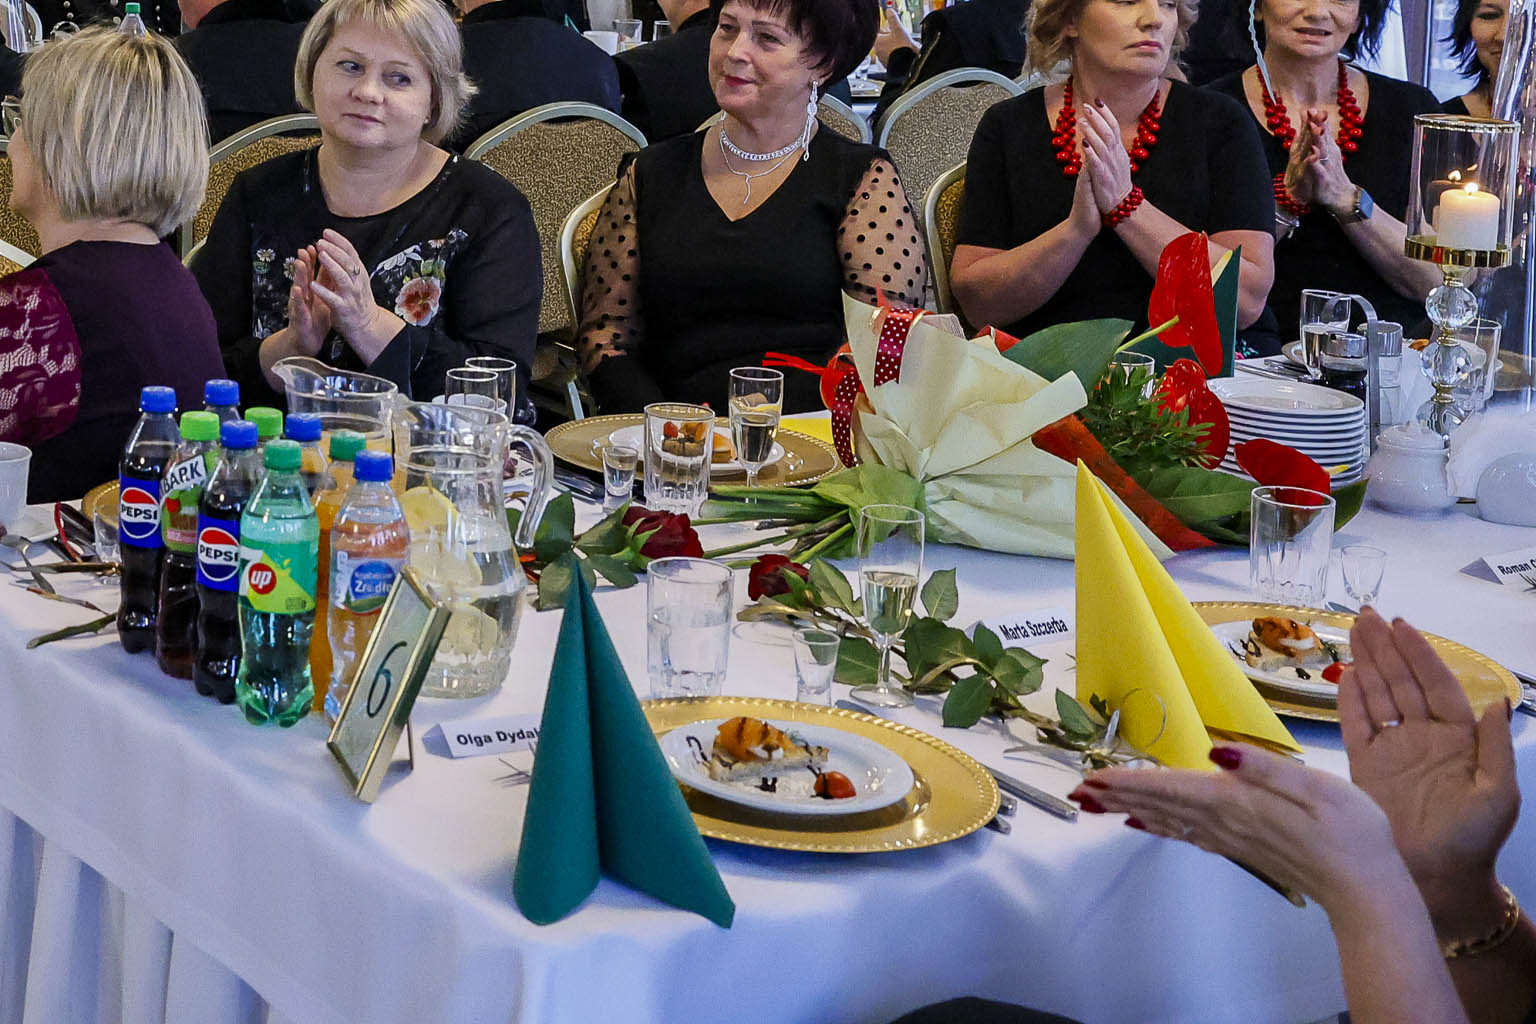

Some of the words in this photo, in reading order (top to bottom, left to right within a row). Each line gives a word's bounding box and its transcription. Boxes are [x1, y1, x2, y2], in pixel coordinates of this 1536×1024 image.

[121, 503, 158, 521] PEPSI
[199, 544, 239, 562] PEPSI
[1497, 562, 1532, 576] Roman
[999, 624, 1030, 640] Marta
[1025, 617, 1069, 637] Szczerba
[366, 641, 407, 718] 6
[457, 733, 493, 747] Olga
